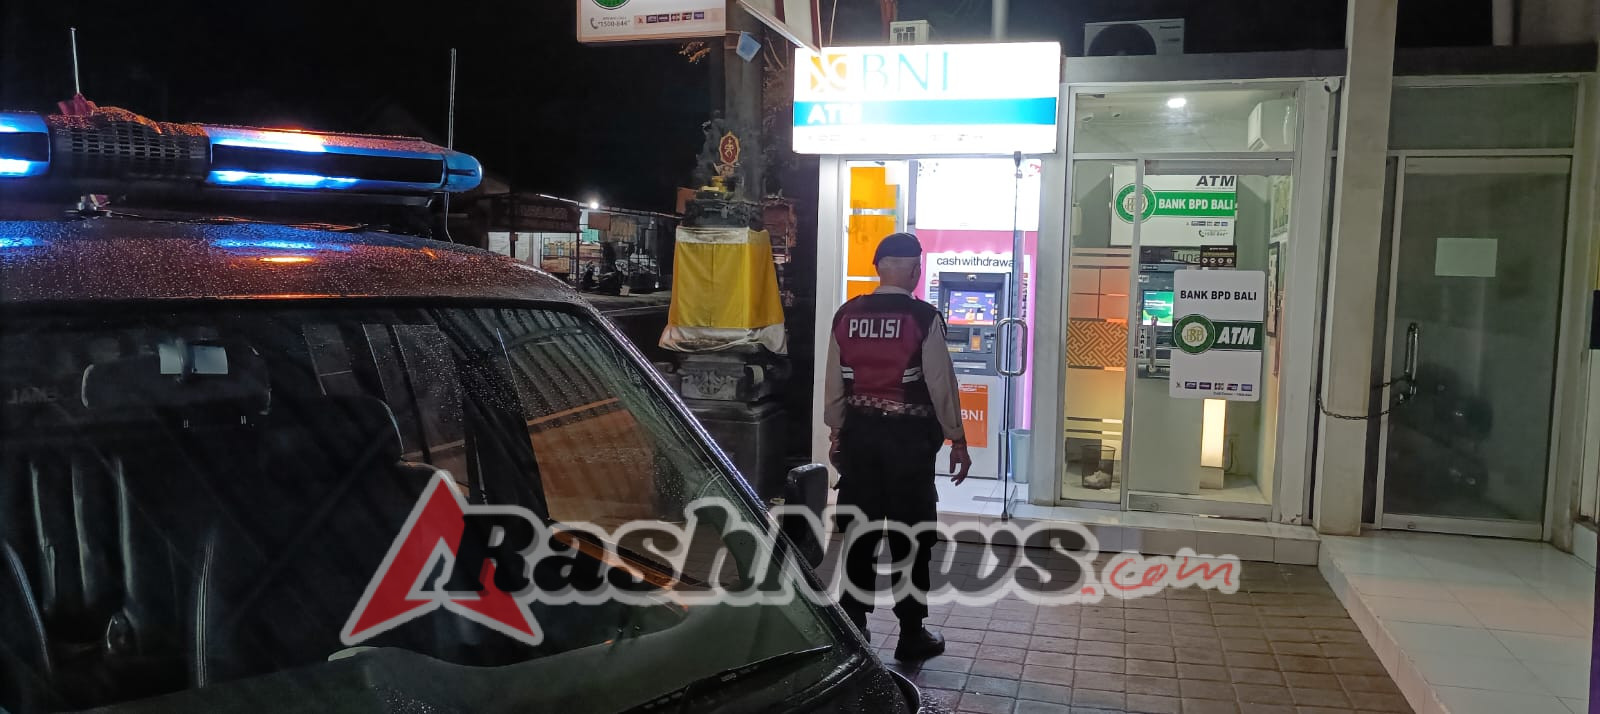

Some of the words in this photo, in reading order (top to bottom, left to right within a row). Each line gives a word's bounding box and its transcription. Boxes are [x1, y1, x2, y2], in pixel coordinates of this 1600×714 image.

[863, 51, 948, 92] BNI
[1196, 175, 1235, 187] ATM
[1158, 198, 1186, 210] BANK
[1188, 199, 1209, 210] BPD
[1210, 199, 1234, 211] BALI
[1180, 290, 1209, 300] BANK
[1211, 290, 1231, 301] BPD
[1234, 291, 1257, 301] BALI
[848, 318, 901, 339] POLISI
[1217, 326, 1256, 345] ATM
[960, 409, 984, 421] BNI
